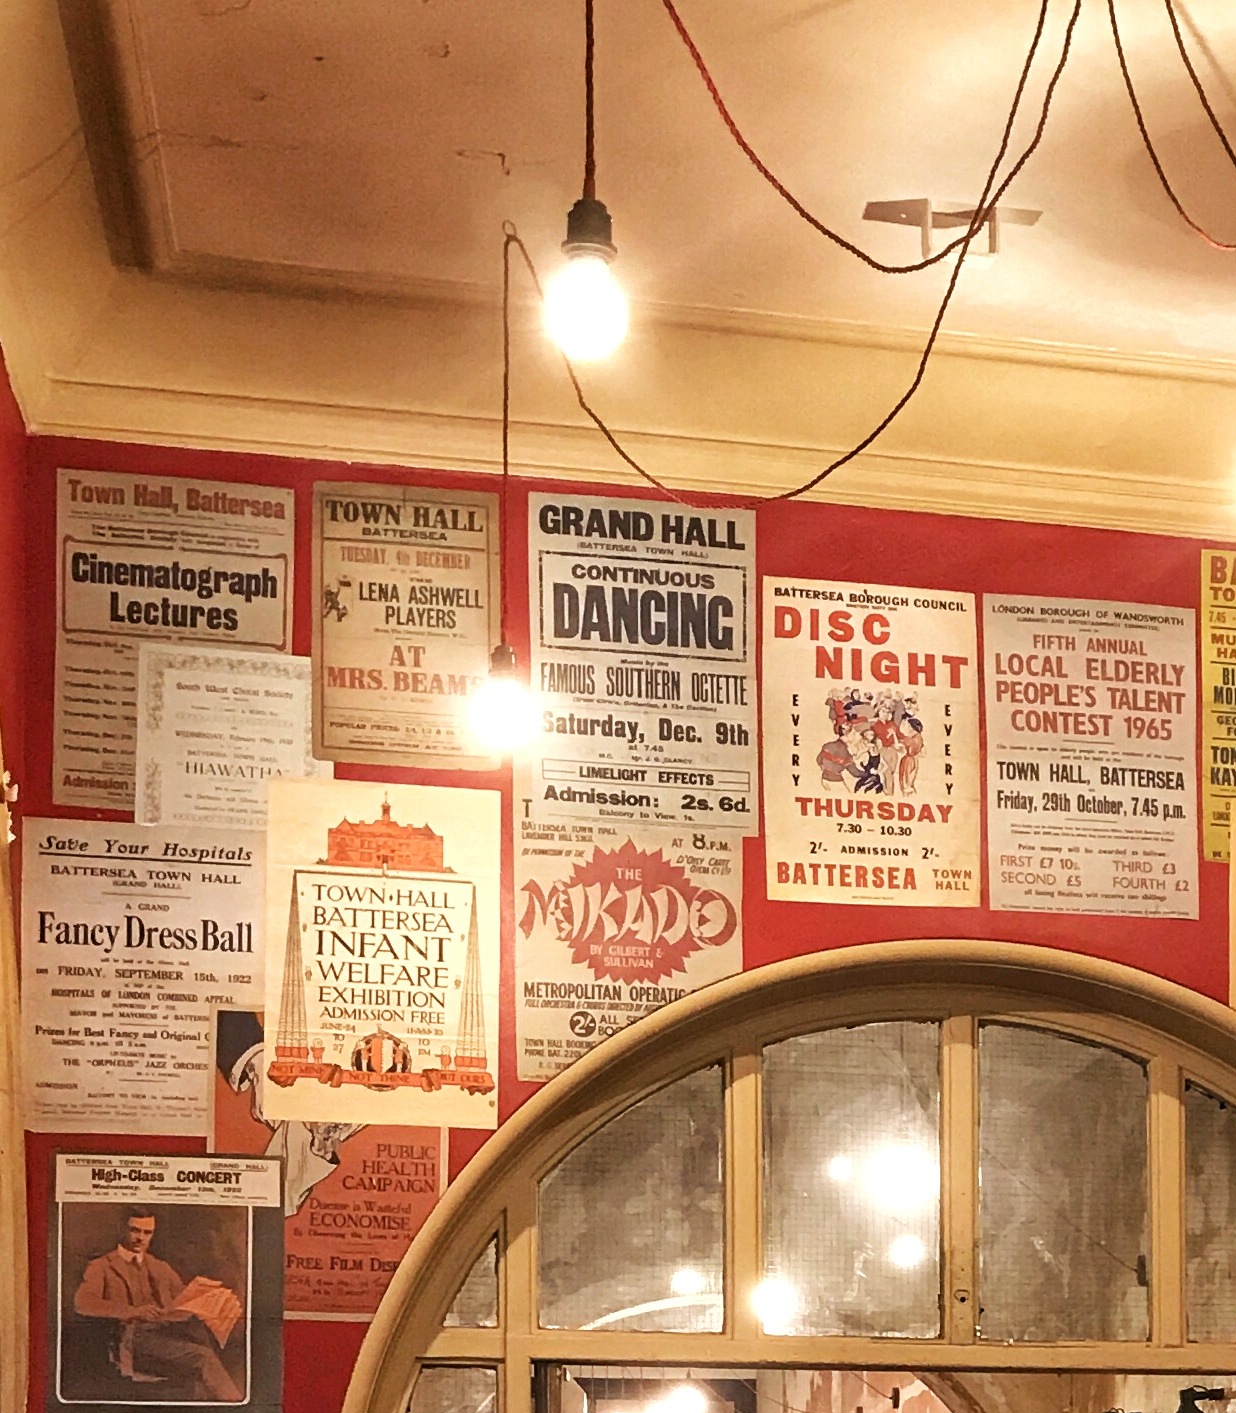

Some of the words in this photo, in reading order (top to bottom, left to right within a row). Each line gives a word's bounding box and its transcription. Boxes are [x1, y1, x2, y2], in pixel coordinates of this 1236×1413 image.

[68, 479, 125, 505] Town
[134, 484, 178, 514] Hall,
[186, 488, 285, 519] Battersea
[325, 499, 401, 525] TOWN
[413, 504, 484, 532] HALL
[539, 504, 654, 541] GRAND
[661, 513, 745, 551] HALL
[72, 552, 277, 604] Cinematograph
[571, 563, 715, 590] CONTINUOUS
[359, 581, 400, 602] LENA
[408, 585, 484, 609] ASHWELL
[774, 587, 844, 603] BATTERSEA
[914, 599, 967, 613] COUNCIL
[110, 591, 238, 631] Lectures
[385, 605, 457, 629] PLAYERS
[553, 581, 733, 651] DANCING
[992, 604, 1035, 616] LONDON
[1040, 606, 1091, 619] BOROUGH
[1096, 609, 1109, 619] OF
[1114, 610, 1184, 627] WANDSWORTH
[774, 605, 891, 646] DISC
[389, 644, 426, 668] AT
[1033, 633, 1076, 652] FIFTH
[1086, 637, 1148, 657] ANNUAL
[326, 667, 387, 691] MRS.
[815, 645, 968, 689] NIGHT
[995, 652, 1069, 679] LOCAL
[1086, 657, 1186, 687] ELDERLY
[540, 662, 596, 696] FAMOUS
[606, 665, 681, 702] SOUTHERN
[691, 671, 748, 706] OCTETTE
[996, 680, 1097, 708] PEOPLE'S
[1107, 687, 1187, 714] TALENT
[542, 710, 645, 744] Saturday,
[658, 718, 702, 744] Dec.
[715, 722, 749, 747] 9th
[1011, 709, 1113, 737] CONTEST
[1124, 716, 1172, 741] 1965
[579, 766, 648, 783] LIMELIGHT
[659, 770, 715, 786] EFFECTS
[996, 761, 1040, 782] TOWN
[1101, 766, 1186, 792] BATTERSEA
[680, 794, 714, 812] 2s.
[719, 796, 750, 813] 6d.
[794, 796, 954, 824] THURSDAY
[1042, 792, 1071, 813] 29th
[1131, 797, 1159, 817] 7.45
[39, 834, 88, 853] Save
[104, 838, 149, 856] Your
[161, 842, 252, 863] Hospitals
[840, 845, 909, 857] ADMISSION
[1000, 854, 1033, 867] FIRST
[51, 864, 137, 881] BATTERSEA
[147, 869, 191, 882] TOWN
[201, 873, 242, 885] HALL
[616, 866, 643, 881] THE
[777, 861, 917, 891] BATTERSEA
[932, 869, 972, 880] TOWN
[1000, 871, 1056, 886] SECOND
[1113, 860, 1153, 874] THIRD
[312, 883, 386, 905] TOWN
[396, 889, 456, 910] HALL
[935, 880, 970, 892] HALL
[1112, 877, 1166, 891] FOURTH
[313, 906, 454, 933] BATTERSEA
[519, 878, 738, 946] MIKADO
[38, 911, 121, 954] Fancy
[124, 914, 198, 951] Dress
[201, 919, 254, 954] Ball
[315, 929, 452, 963] INFANT
[316, 960, 449, 989] WELFARE
[318, 986, 446, 1009] EXHIBITION
[524, 981, 622, 1001] METROPOLITAN
[319, 1005, 404, 1023] ADMISSION
[410, 1010, 445, 1025] FREE
[377, 1143, 436, 1160] PUBLIC
[176, 1170, 242, 1186] CONCERT
[361, 1160, 436, 1178] HEALTH
[342, 1174, 436, 1194] CAMPAIGN
[309, 1212, 411, 1231] ECONOMISE
